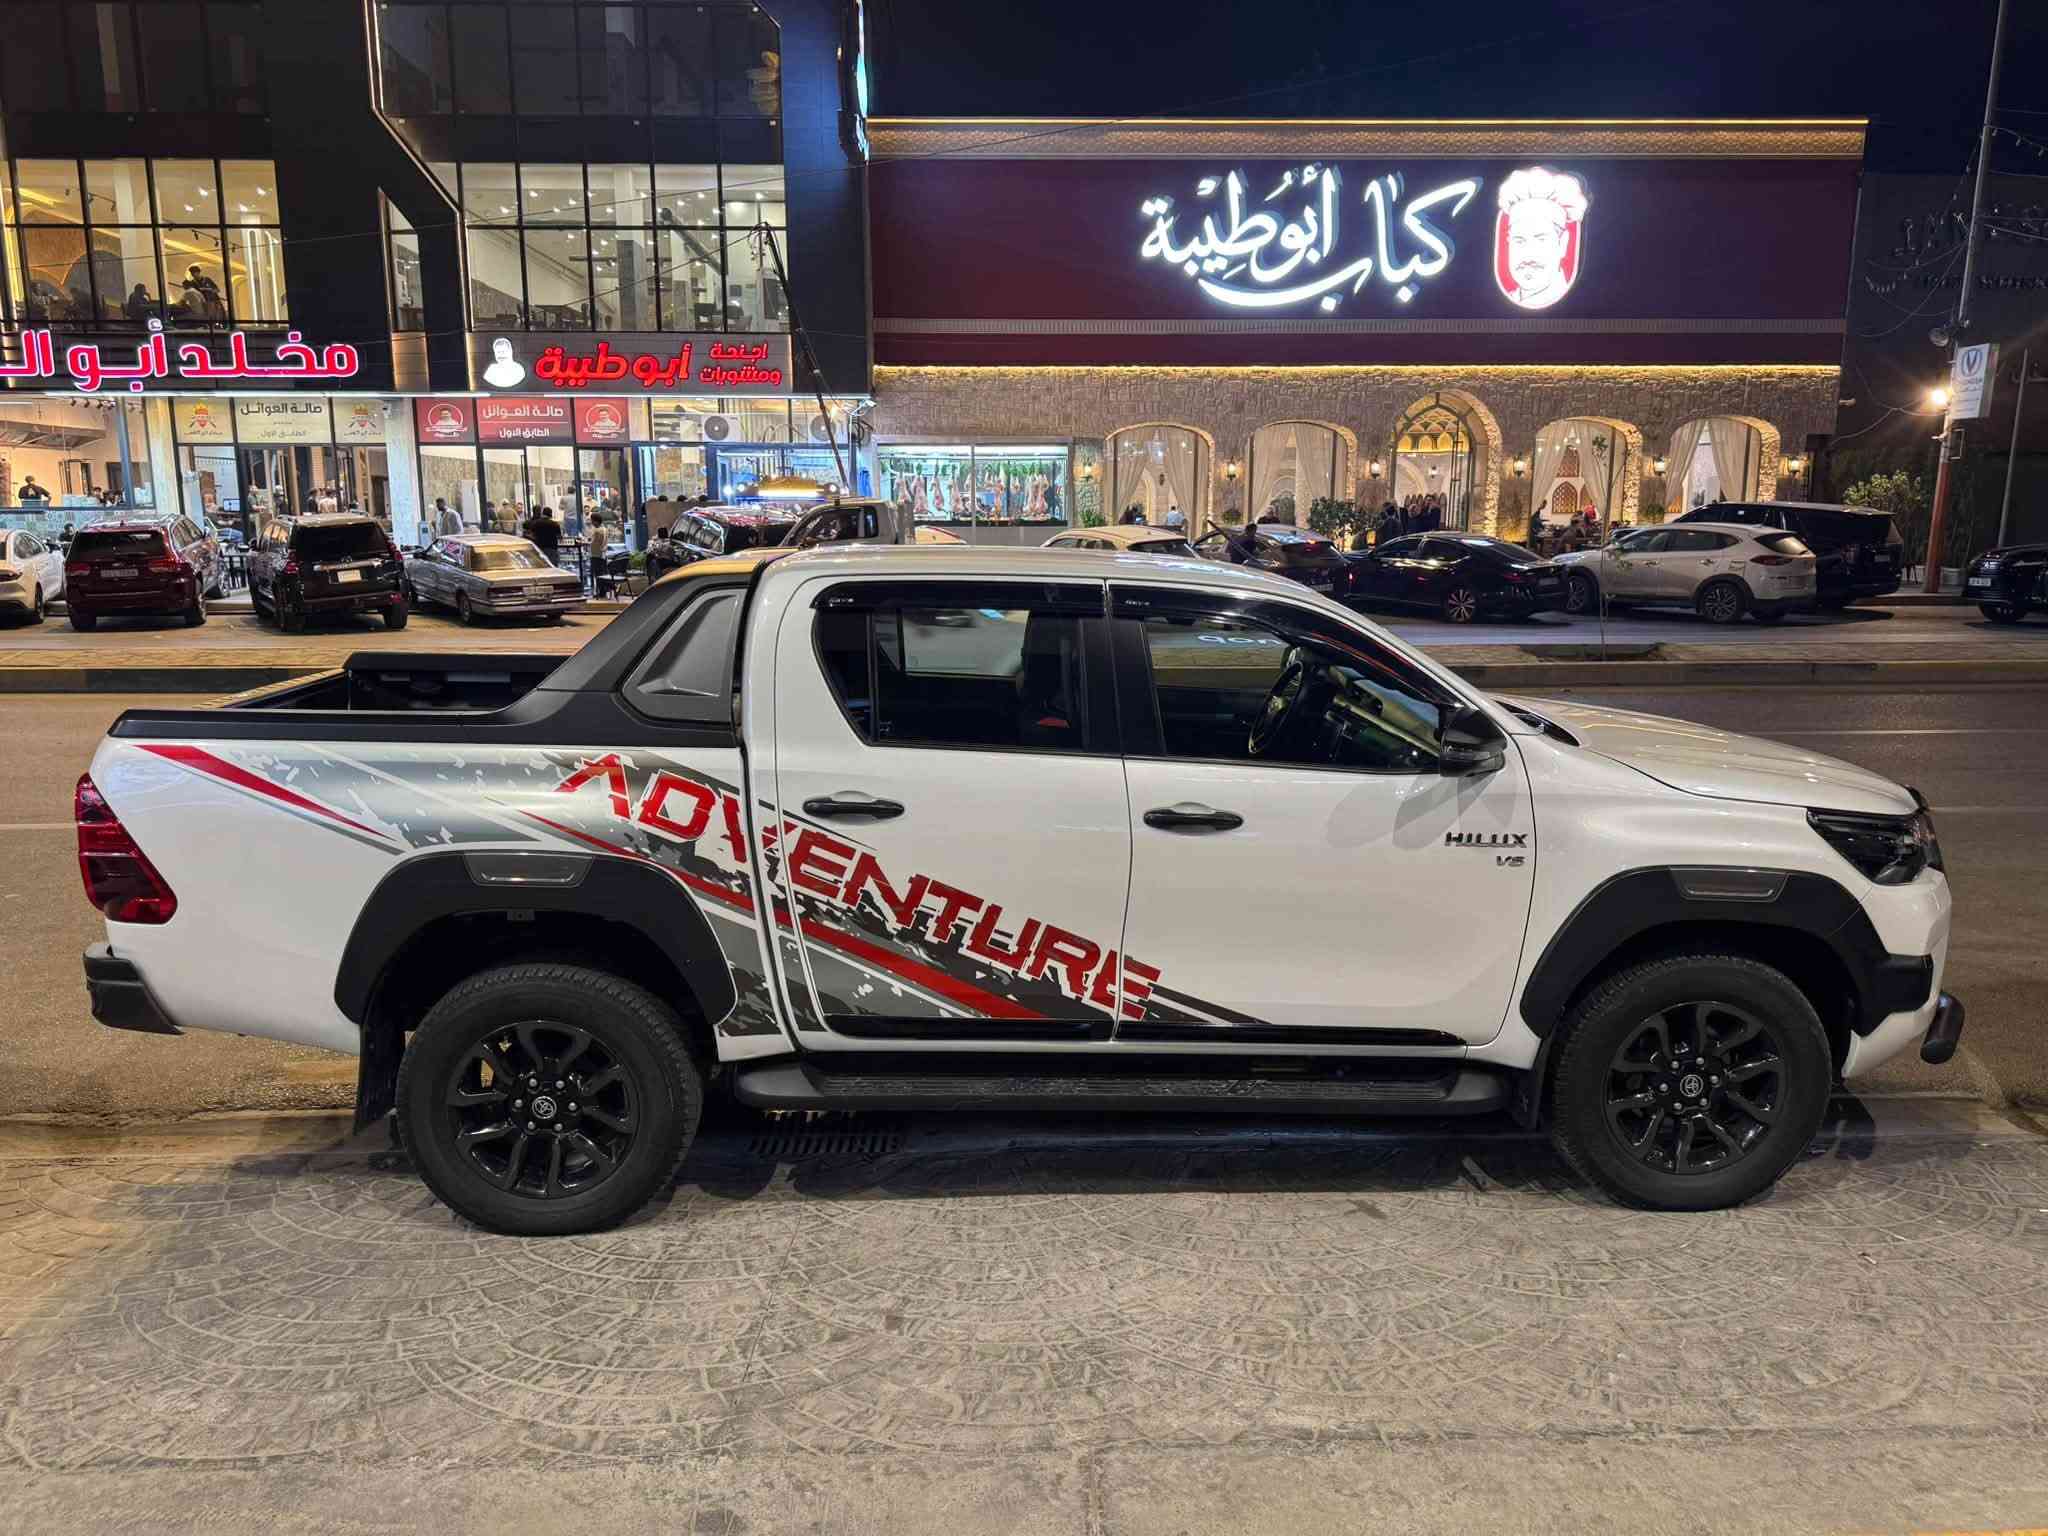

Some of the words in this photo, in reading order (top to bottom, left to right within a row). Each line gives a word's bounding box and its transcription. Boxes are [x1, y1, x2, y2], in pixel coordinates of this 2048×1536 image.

[67, 318, 170, 393] أبو
[180, 331, 359, 378] مخلد
[535, 342, 628, 387] طيبة
[633, 343, 693, 387] أبو
[240, 400, 288, 416] العوائل
[532, 405, 564, 417] صالة
[1443, 831, 1528, 849] HILUX
[552, 751, 1162, 1022] ADVENTURE
